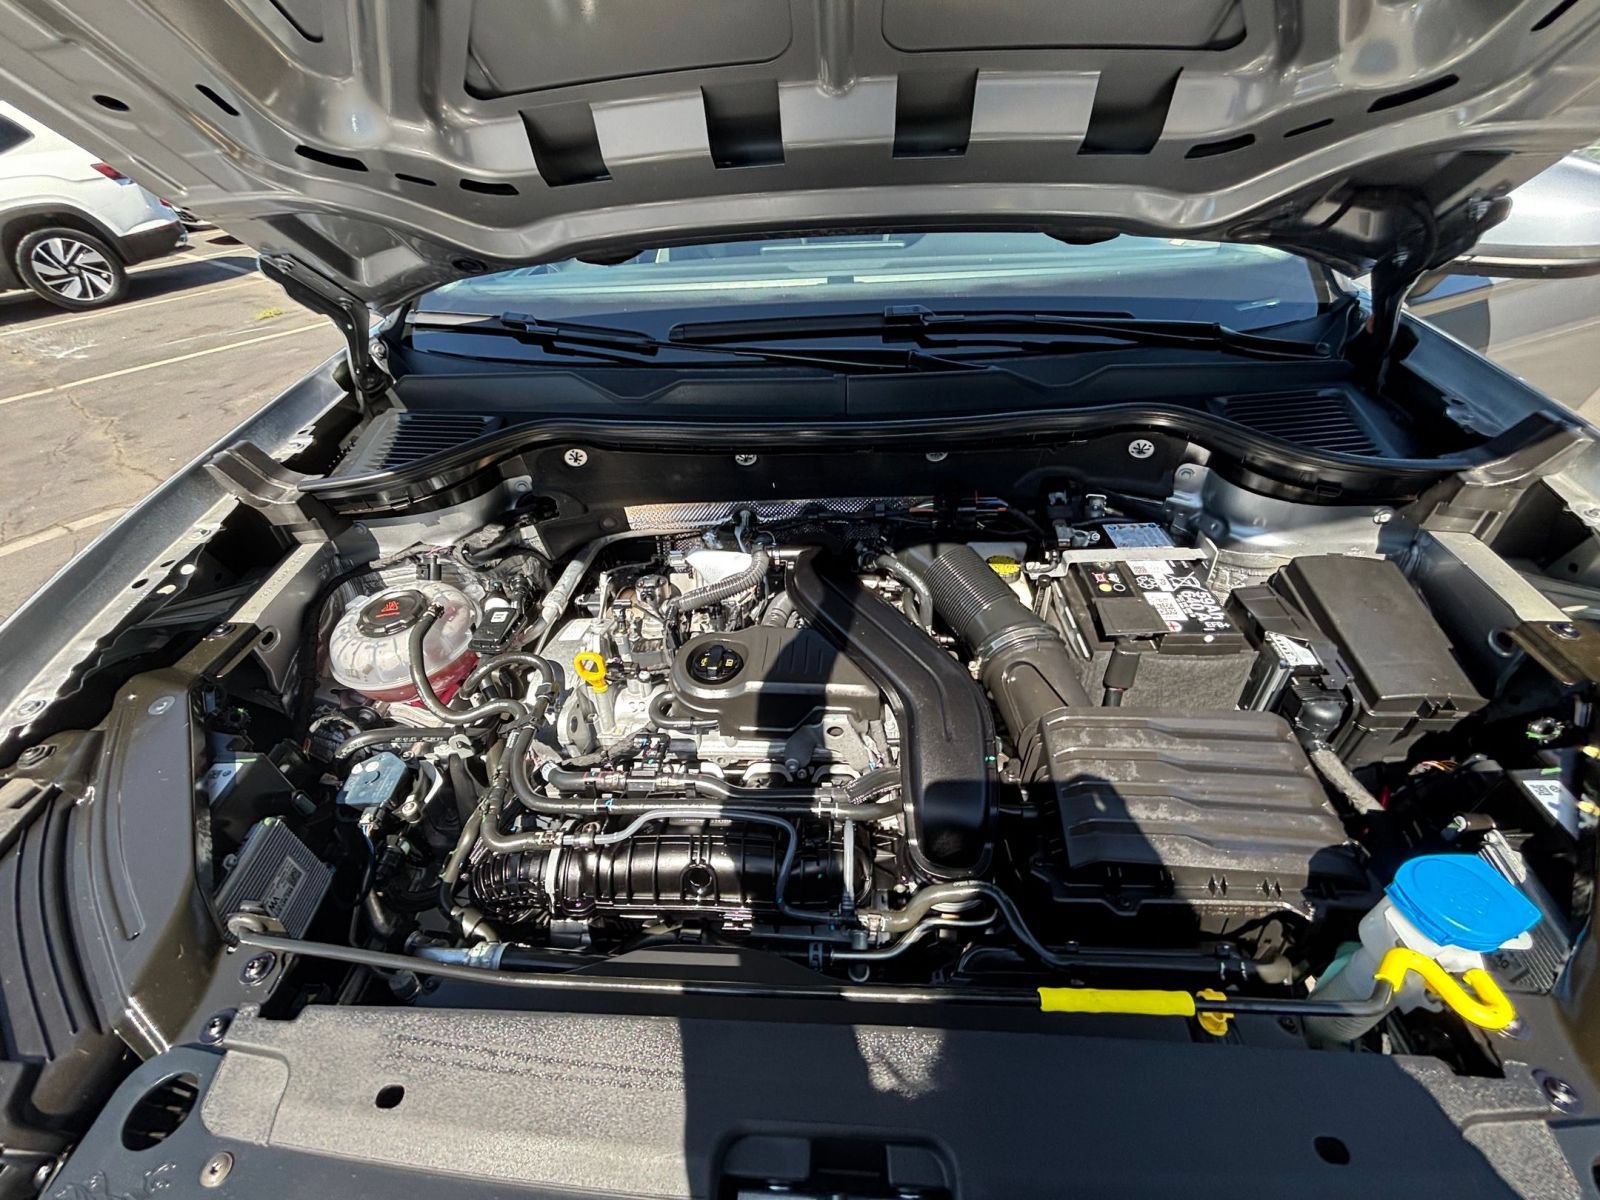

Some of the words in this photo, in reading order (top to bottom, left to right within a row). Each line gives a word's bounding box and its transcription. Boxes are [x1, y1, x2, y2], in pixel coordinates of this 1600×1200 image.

[1182, 591, 1205, 610] 640
[1195, 612, 1211, 622] A
[1196, 592, 1225, 621] 59Ah
